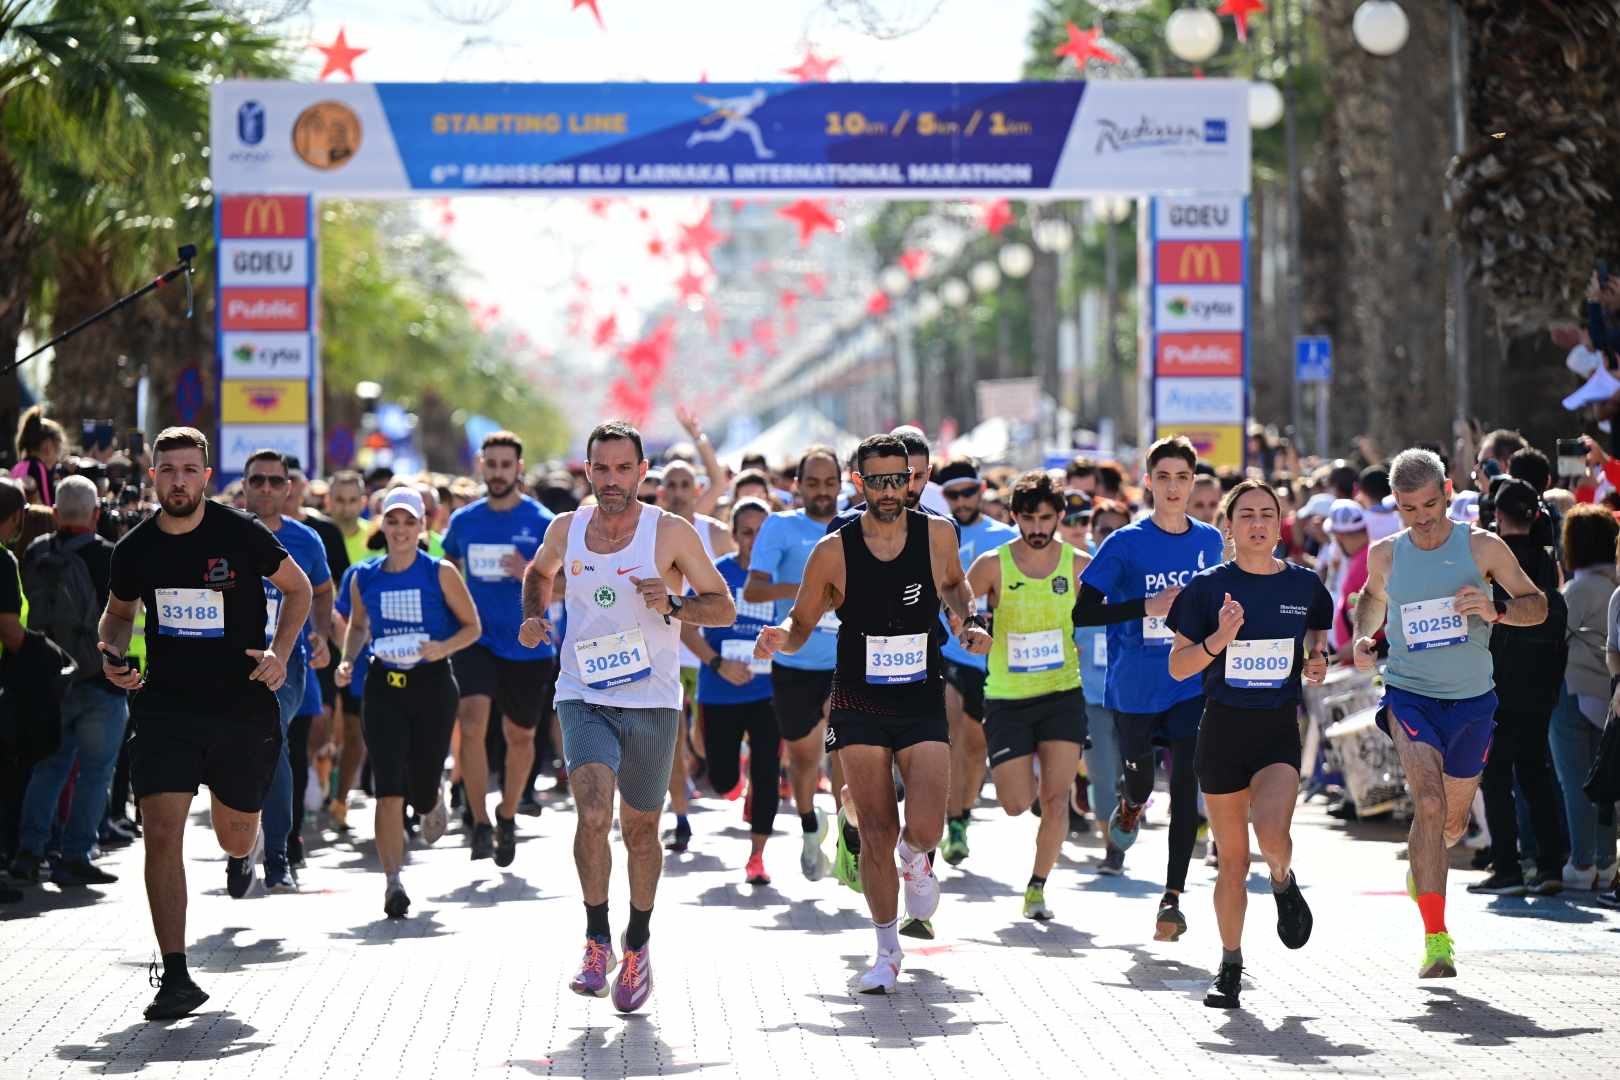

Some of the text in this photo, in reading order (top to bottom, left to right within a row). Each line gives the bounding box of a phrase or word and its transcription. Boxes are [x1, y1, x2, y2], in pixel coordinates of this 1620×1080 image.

[431, 112, 626, 135] STARTING LINE
[463, 163, 575, 184] RADISSON
[577, 163, 622, 184] BLU
[624, 163, 731, 184] LARNAKA
[733, 163, 905, 184] INTERNATIONAL
[908, 163, 1033, 184] MARATHON
[227, 299, 298, 320] Public
[1163, 343, 1233, 365] Public
[584, 563, 595, 571] NN
[162, 604, 218, 620] 33188
[1408, 614, 1463, 635] 30258
[585, 647, 641, 674] 30261
[872, 650, 924, 667] 33982
[1013, 643, 1059, 659] 31394
[1231, 656, 1289, 671] 30809
